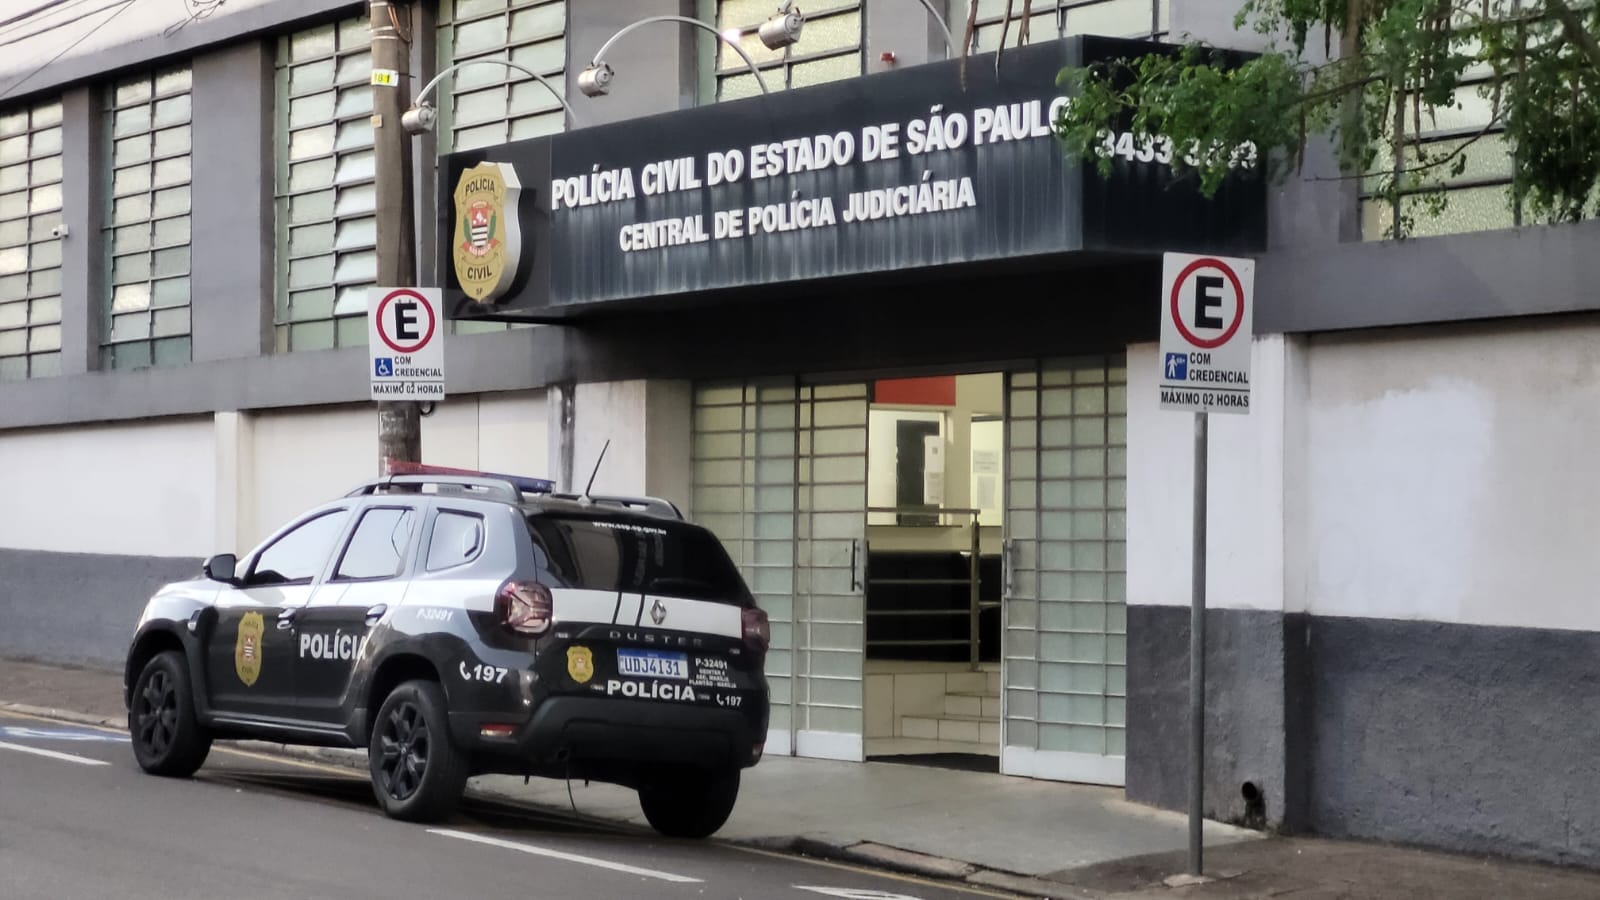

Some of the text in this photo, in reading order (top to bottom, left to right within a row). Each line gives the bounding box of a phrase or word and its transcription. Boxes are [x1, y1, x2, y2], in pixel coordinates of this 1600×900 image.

[1094, 128, 1173, 164] 3433
[552, 163, 635, 210] POLÍCIA
[642, 157, 701, 196] CIVIL
[707, 149, 744, 187] DO
[750, 131, 855, 180] ESTADO
[862, 123, 900, 162] DE
[906, 104, 968, 155] SÃO
[465, 176, 495, 196] POLÍCIA
[620, 170, 976, 252] CENTRAL DE POLÍCIA JUDICIÁRIA
[467, 265, 493, 280] CIVIL
[1194, 275, 1224, 329] E
[395, 303, 419, 340] E
[394, 356, 412, 364] COM
[1189, 352, 1211, 364] COM
[394, 368, 442, 377] CREDENCIAL
[1189, 369, 1249, 384] CREDENCIAL
[406, 385, 415, 394] 02
[417, 385, 443, 394] HORAS
[1161, 388, 1249, 408] MÁXIMO 02 HORAS
[300, 628, 367, 660] POLÍCIA
[609, 631, 702, 646] DUSTER
[695, 657, 728, 669] P-32491
[473, 664, 508, 684] 197
[607, 679, 695, 701] POLÍCIA
[725, 695, 742, 707] 197
